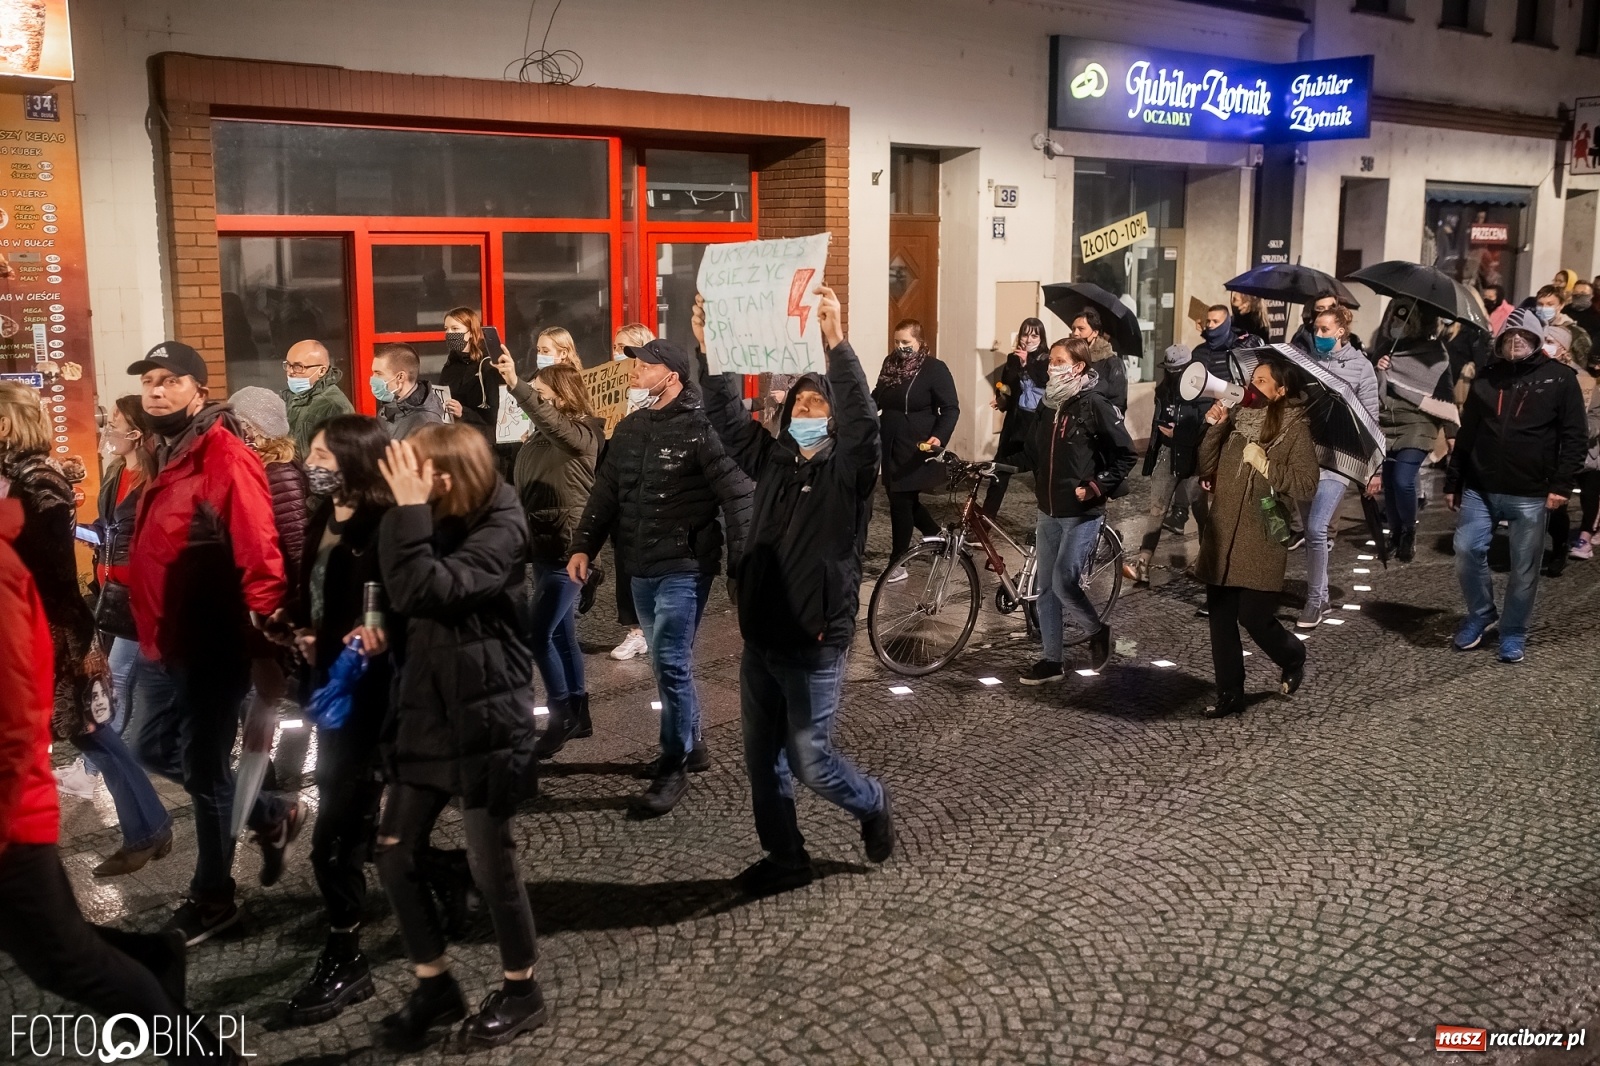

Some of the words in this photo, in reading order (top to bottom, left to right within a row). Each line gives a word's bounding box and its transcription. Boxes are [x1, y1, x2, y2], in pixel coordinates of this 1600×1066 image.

[1126, 60, 1202, 119] Jubiler
[1200, 69, 1272, 121] Złotnik
[1291, 74, 1353, 106] Jubiler
[32, 95, 52, 111] 34
[1290, 105, 1353, 133] Złotnik
[26, 132, 67, 143] KEBAB
[11, 146, 42, 156] KUBEK
[10, 190, 47, 198] TALERZ
[1001, 189, 1017, 203] 36
[994, 223, 1004, 234] 36
[1471, 227, 1508, 240] PRZECENA
[12, 239, 21, 247] W
[24, 239, 55, 247] BUŁCE
[1083, 229, 1119, 259] ZŁOTO
[1121, 217, 1147, 241] -10%
[1261, 253, 1288, 264] SPRZEDAŻ
[26, 290, 61, 301] CIEŚCIE
[704, 298, 728, 317] TO
[734, 290, 775, 313] TAM
[23, 315, 48, 323] ŚREDNI
[715, 341, 816, 372] UCIEKAJ
